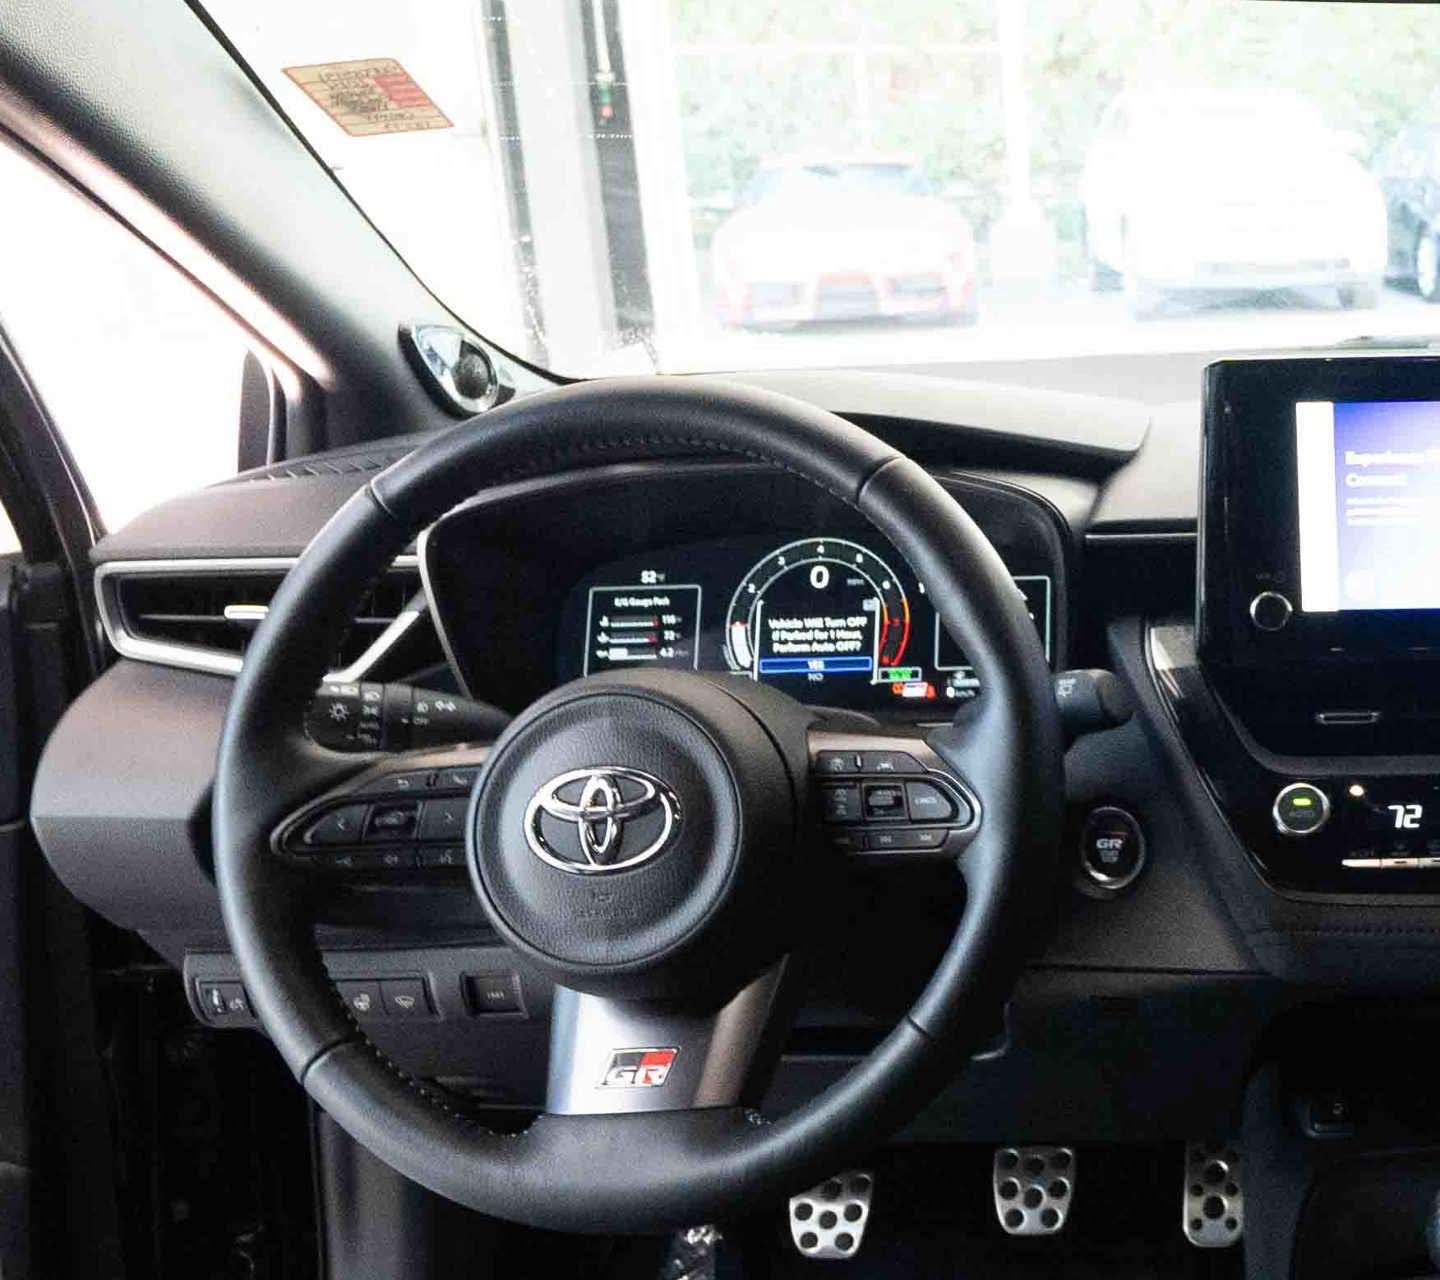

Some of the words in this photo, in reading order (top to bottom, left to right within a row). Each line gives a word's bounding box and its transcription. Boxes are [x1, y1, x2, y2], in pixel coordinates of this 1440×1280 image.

[810, 565, 830, 589] 0
[768, 618, 804, 629] Vehicle
[824, 617, 847, 628] Turn
[847, 616, 868, 627] OFF
[772, 642, 811, 653] Perform
[807, 672, 824, 682] NO
[1388, 804, 1423, 829] 72
[1096, 838, 1123, 849] GR
